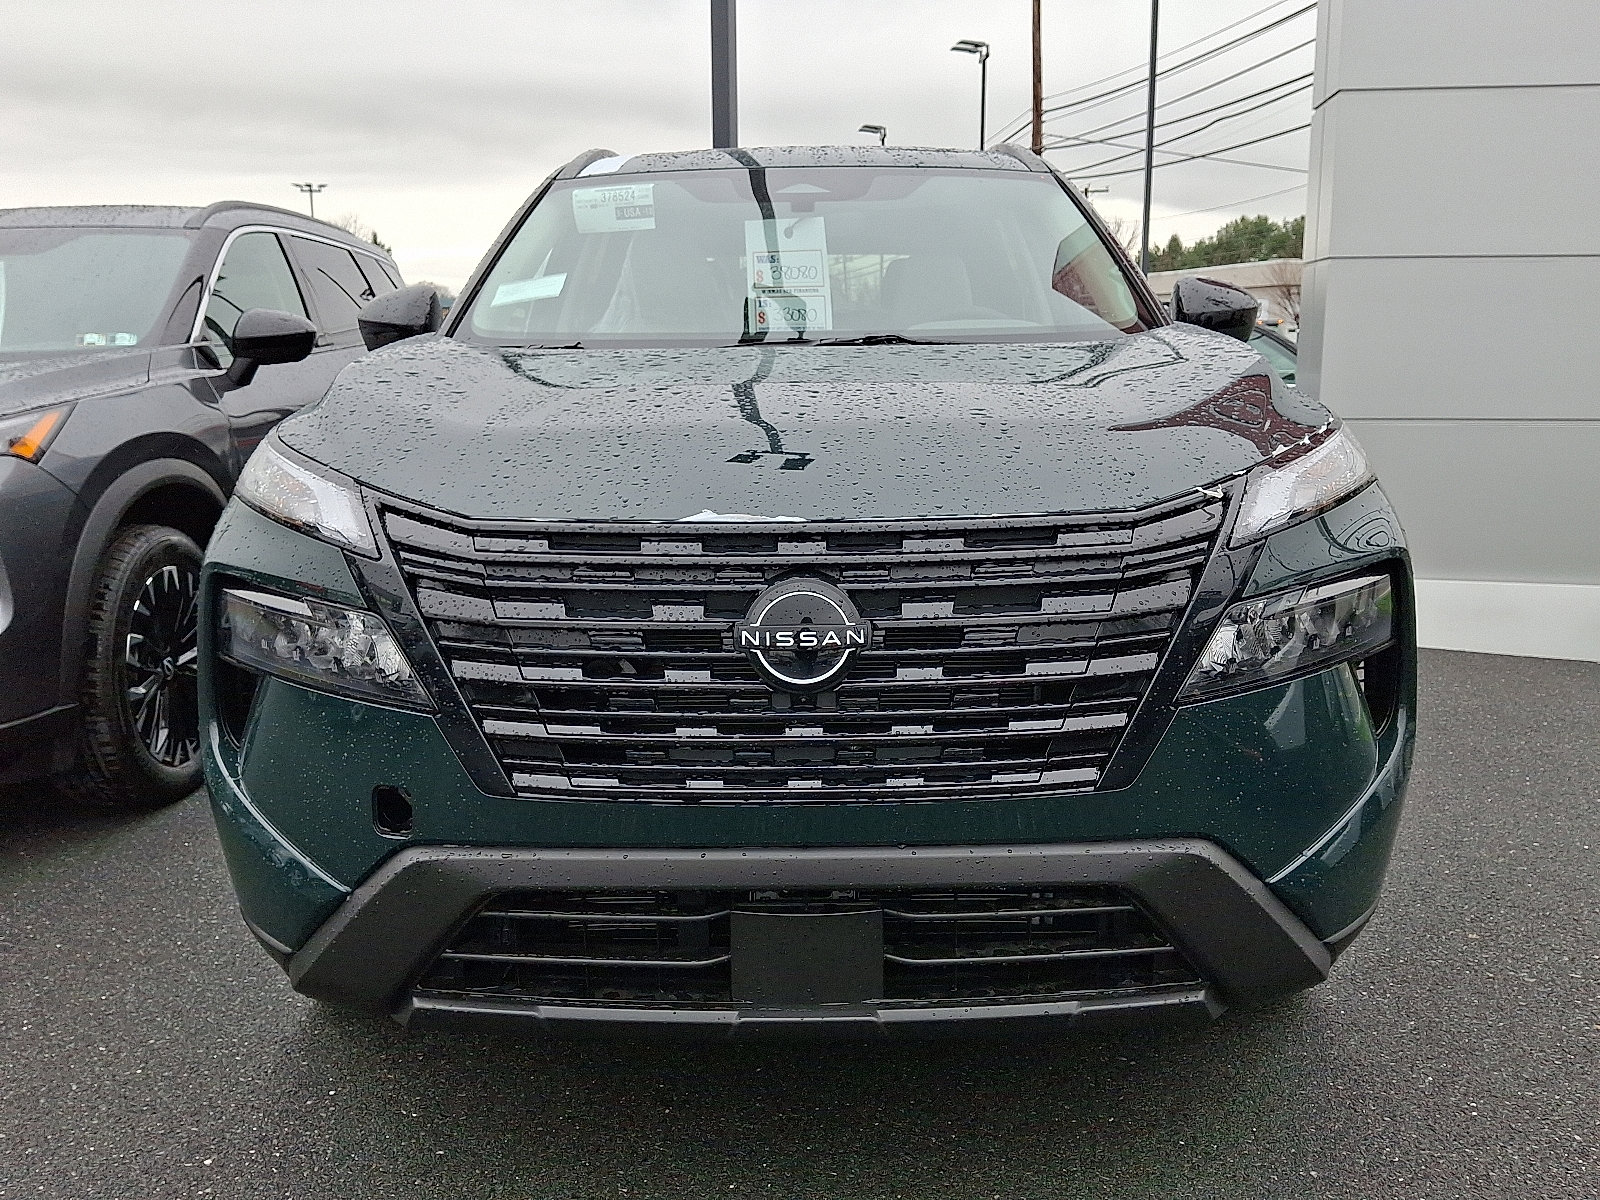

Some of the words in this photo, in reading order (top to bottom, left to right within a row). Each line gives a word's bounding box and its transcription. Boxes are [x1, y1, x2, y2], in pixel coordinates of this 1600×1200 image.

[600, 190, 636, 203] 378524
[756, 255, 780, 264] WAS:
[741, 629, 865, 647] NISSAN
